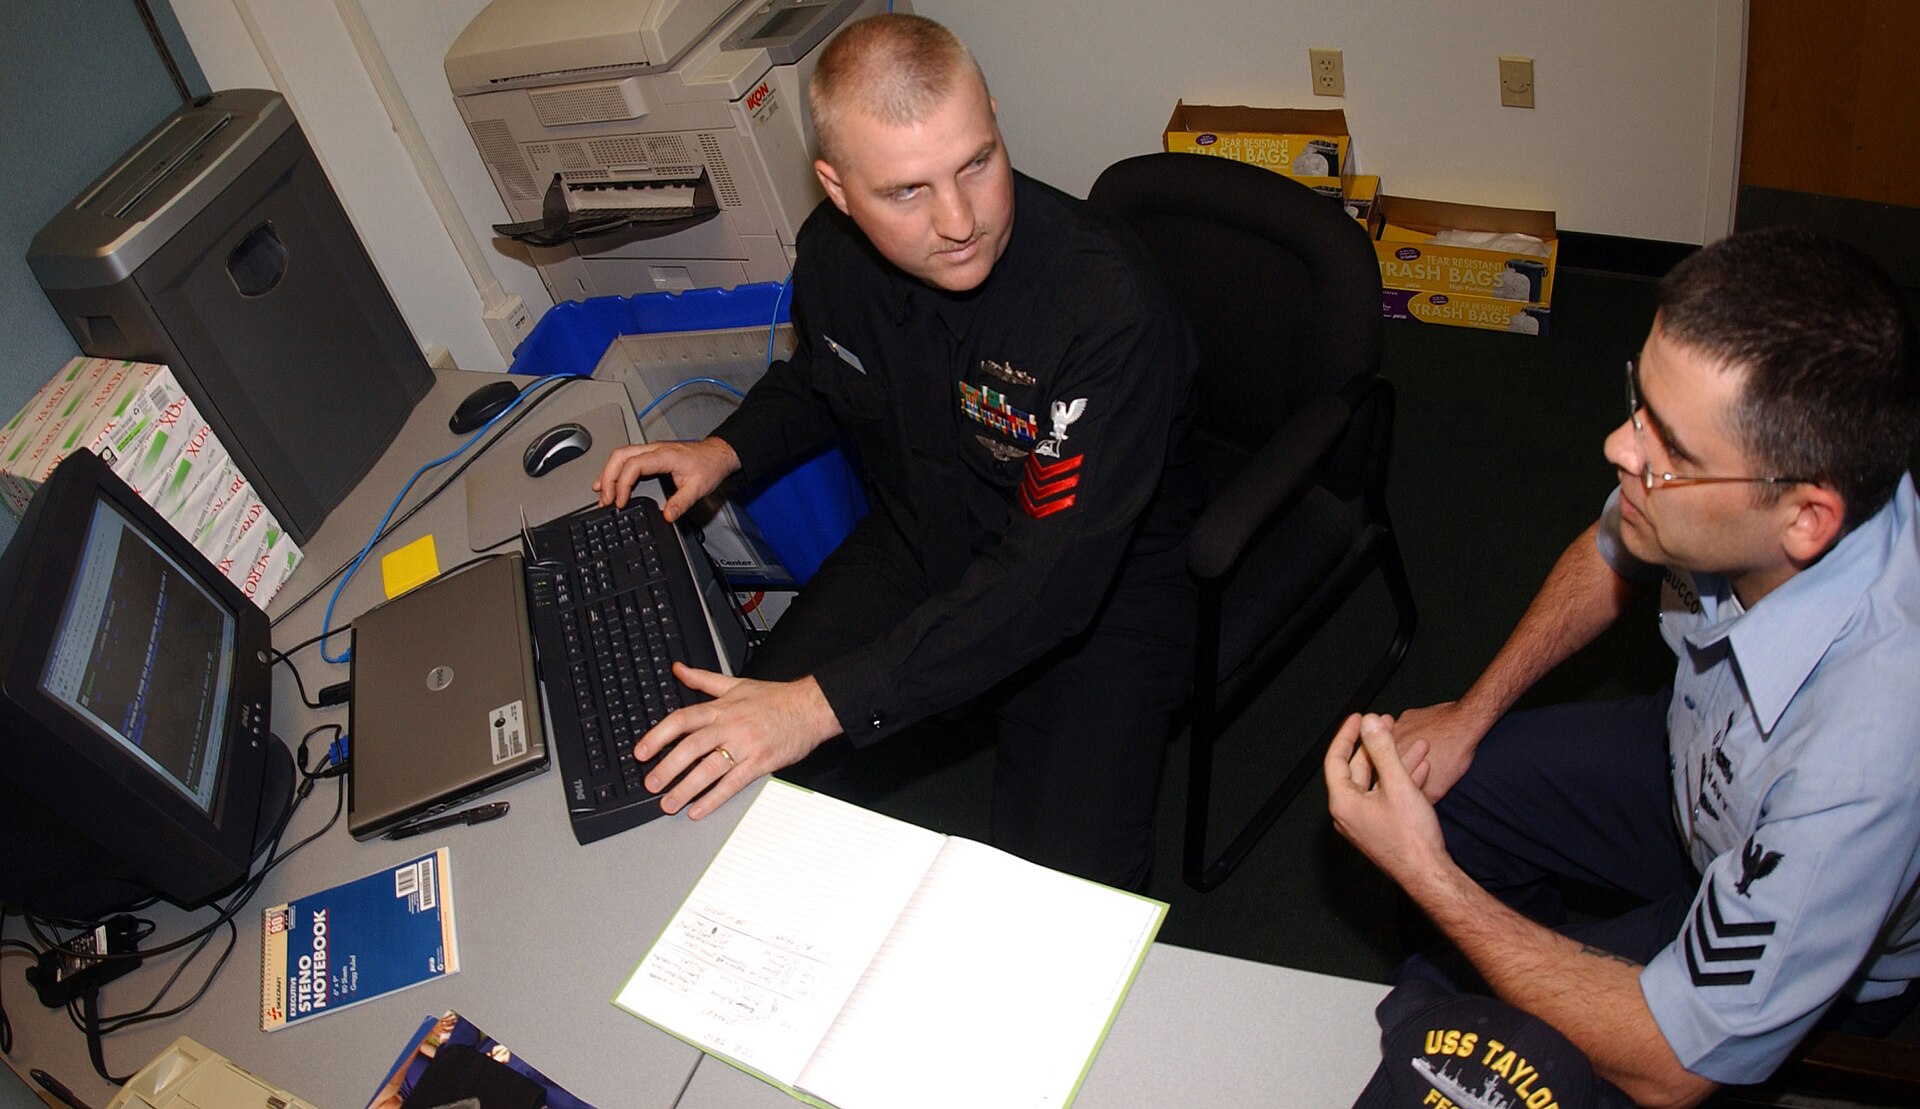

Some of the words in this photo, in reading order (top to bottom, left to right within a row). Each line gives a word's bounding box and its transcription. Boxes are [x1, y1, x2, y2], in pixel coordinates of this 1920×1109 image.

[746, 82, 769, 111] IKON
[1220, 138, 1241, 148] TEAR
[1243, 138, 1289, 149] RESISTANT
[1245, 148, 1290, 164] BAGS
[1379, 261, 1441, 281] TRASH
[1449, 267, 1504, 288] BAGS
[1426, 255, 1449, 267] TEAR
[1453, 257, 1503, 272] RESISTANT
[1413, 303, 1463, 319] TRASH
[1468, 309, 1511, 325] BAGS
[720, 559, 752, 567] Center
[241, 703, 250, 728] DELL
[574, 779, 586, 800] DELL
[270, 914, 284, 934] 80
[313, 908, 327, 1009] NOTEBOOK
[349, 955, 357, 973] Ruled
[298, 955, 312, 1013] STENO
[289, 976, 297, 1017] EXECUTIVE
[1424, 1029, 1479, 1058] USS
